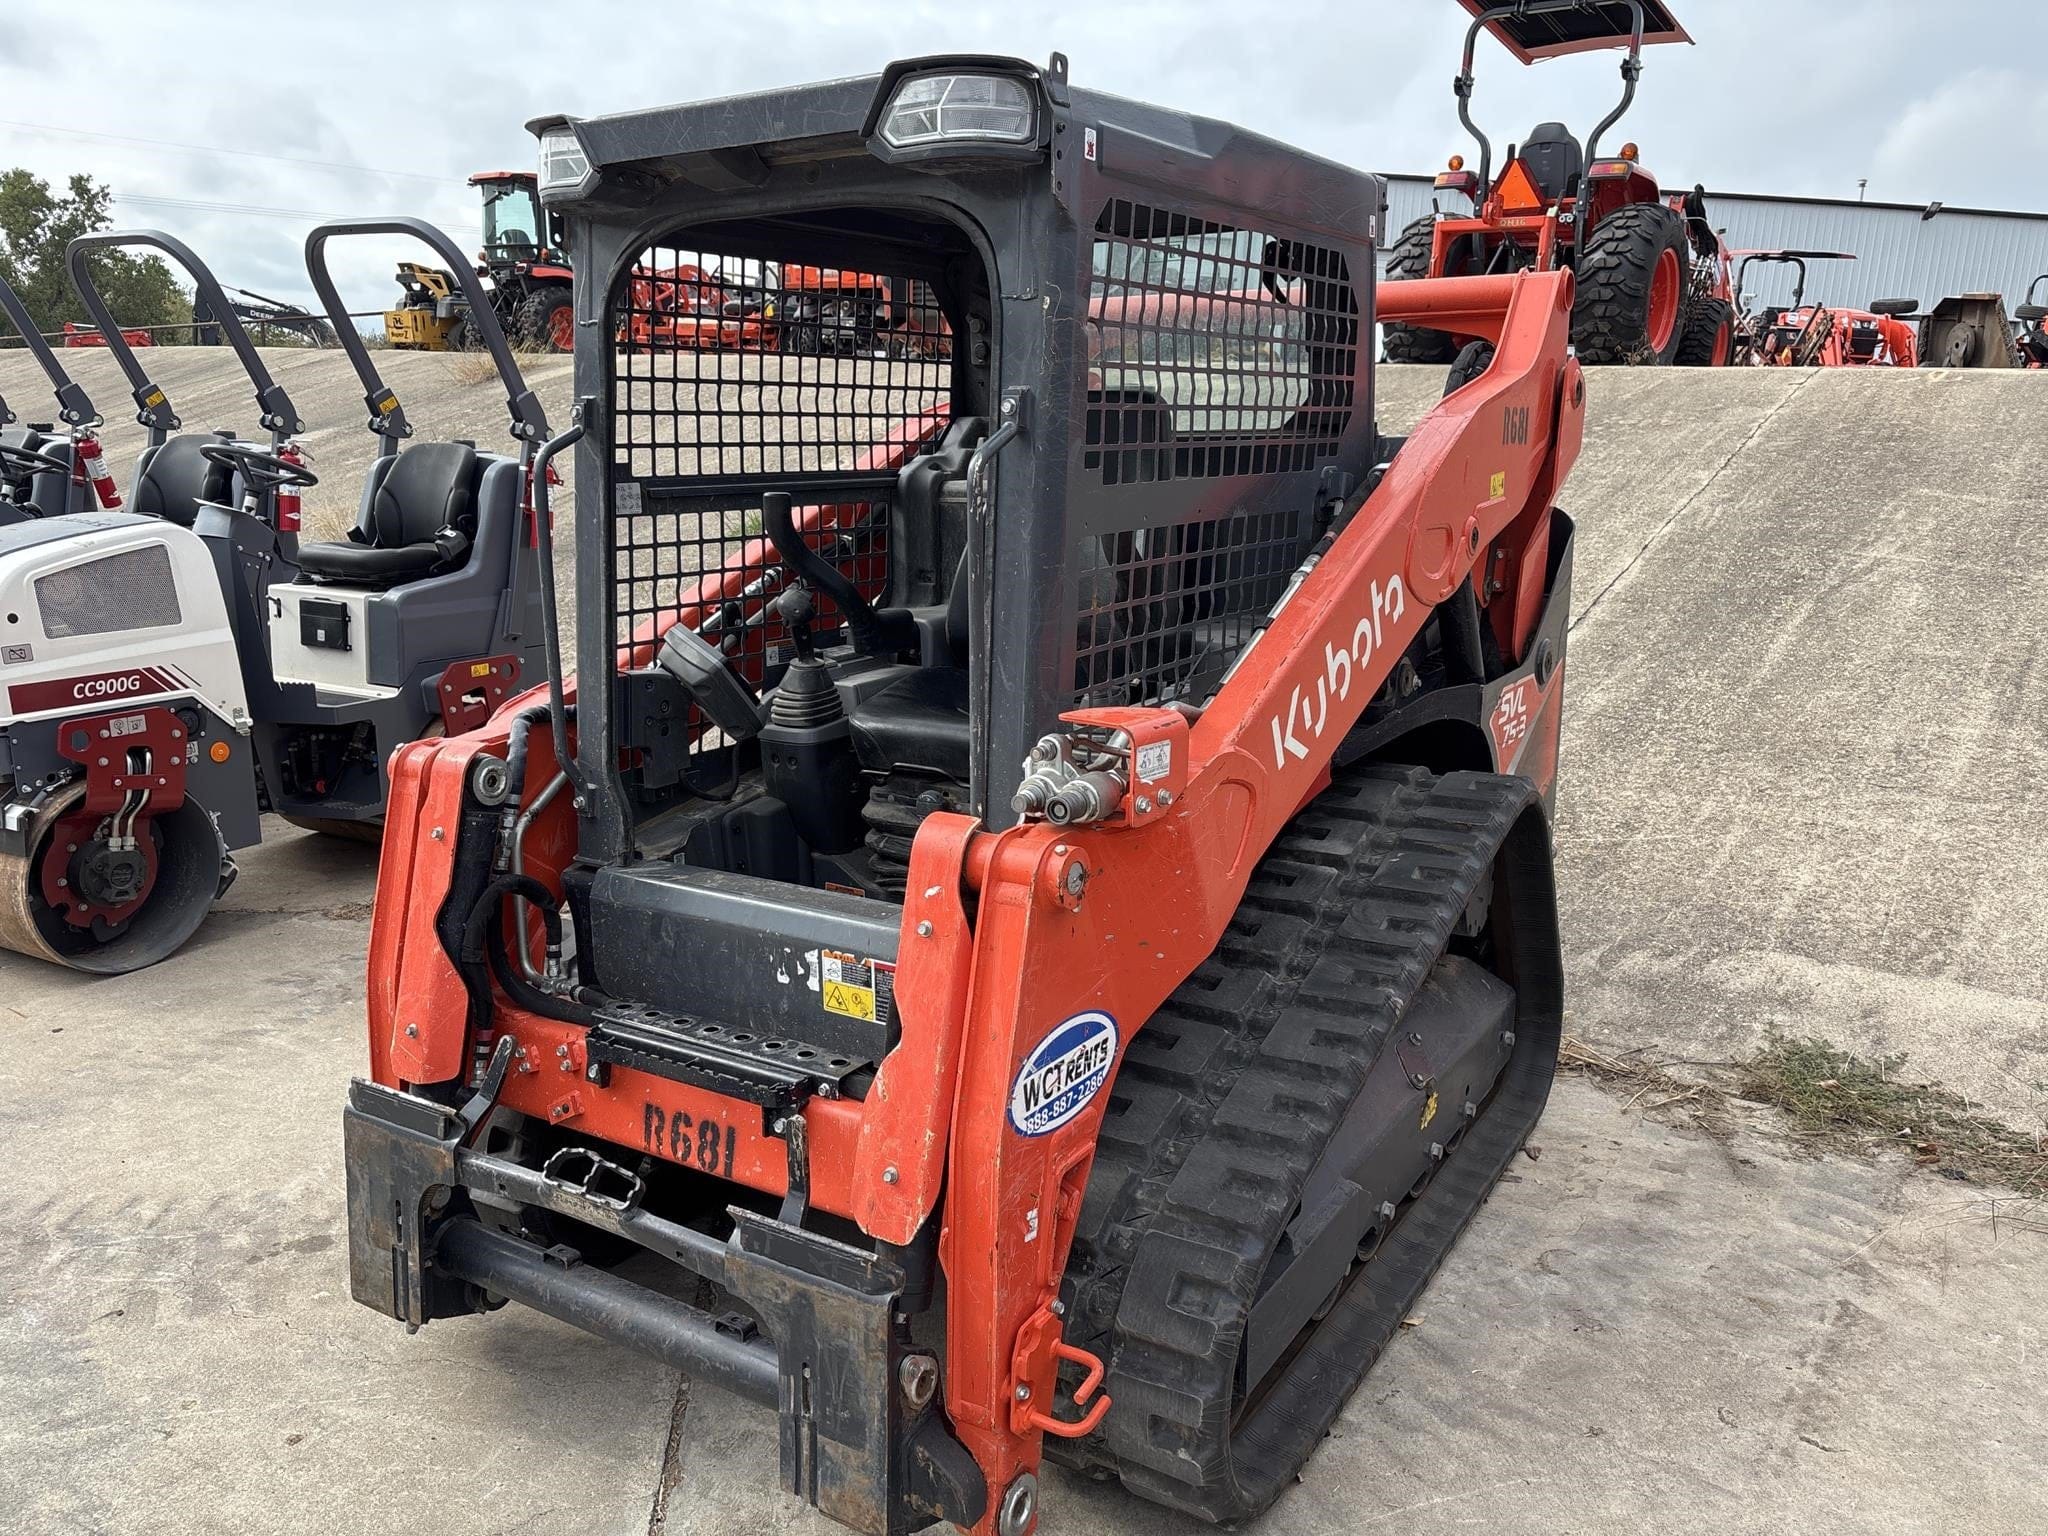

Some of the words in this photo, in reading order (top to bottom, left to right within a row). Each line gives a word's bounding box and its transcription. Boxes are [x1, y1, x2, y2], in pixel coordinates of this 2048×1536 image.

[249, 309, 275, 320] DEERE
[1502, 406, 1530, 446] R681
[73, 675, 141, 699] CC900G
[1271, 574, 1404, 771] Kubota
[1498, 685, 1527, 725] SVL
[1501, 714, 1527, 749] 75-3
[1023, 1058, 1065, 1113] WCT
[1064, 1036, 1109, 1087] RENTS
[1025, 1070, 1105, 1135] 888-887-2286
[643, 1103, 736, 1178] R681
